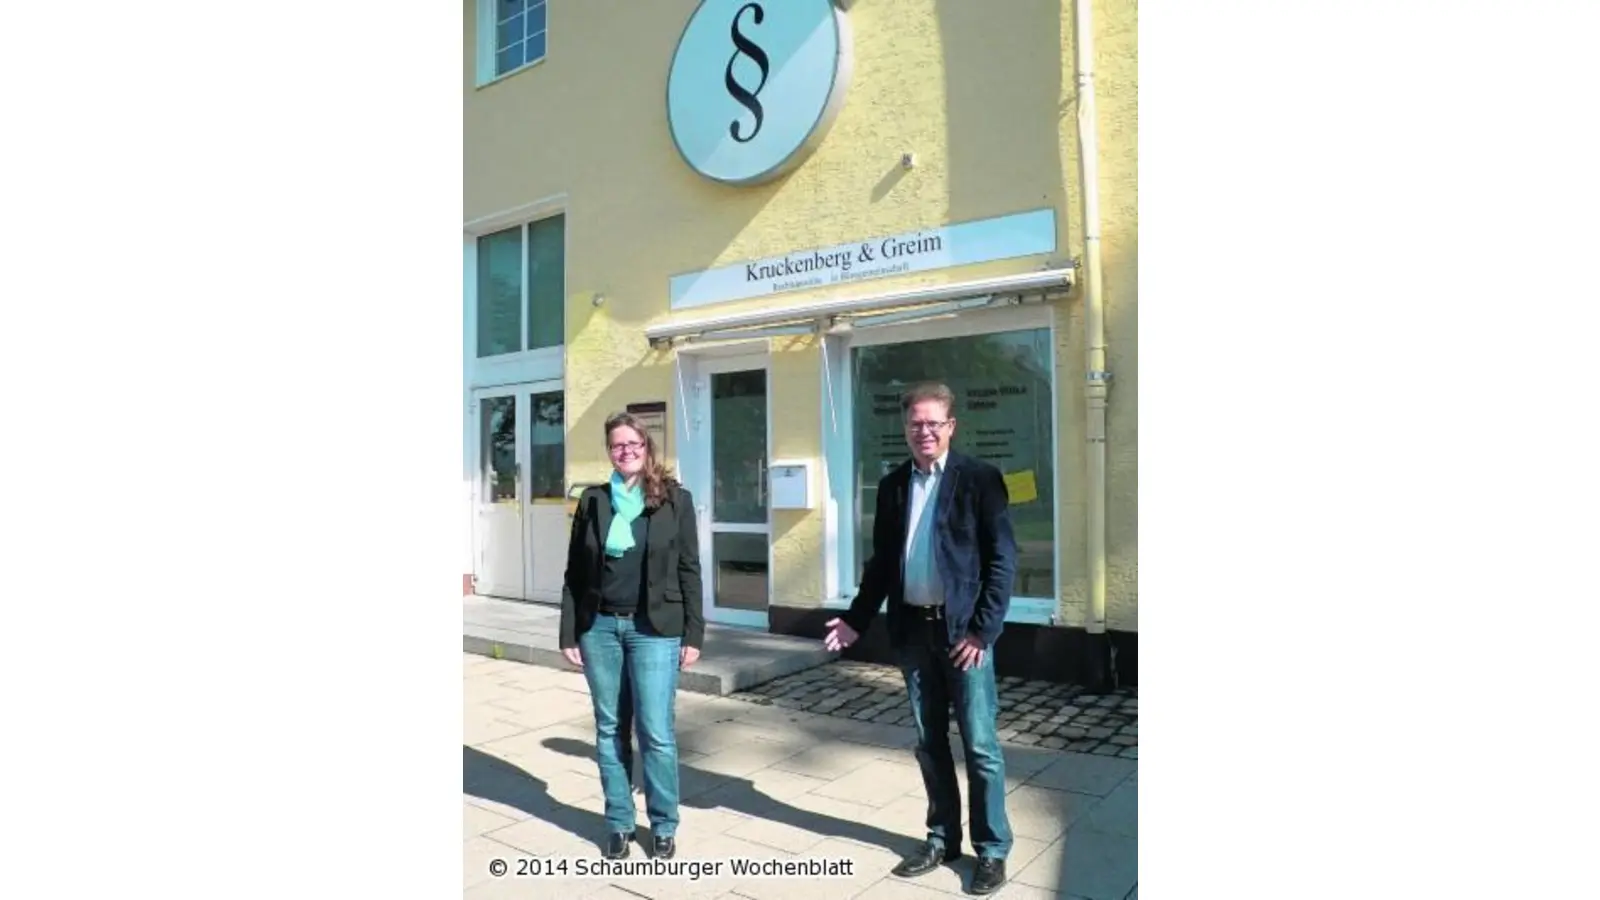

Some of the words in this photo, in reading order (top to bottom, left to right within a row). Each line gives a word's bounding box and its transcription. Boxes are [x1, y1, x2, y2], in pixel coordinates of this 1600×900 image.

[746, 250, 852, 282] Kruckenberg
[858, 242, 875, 263] &
[881, 232, 942, 260] Greim
